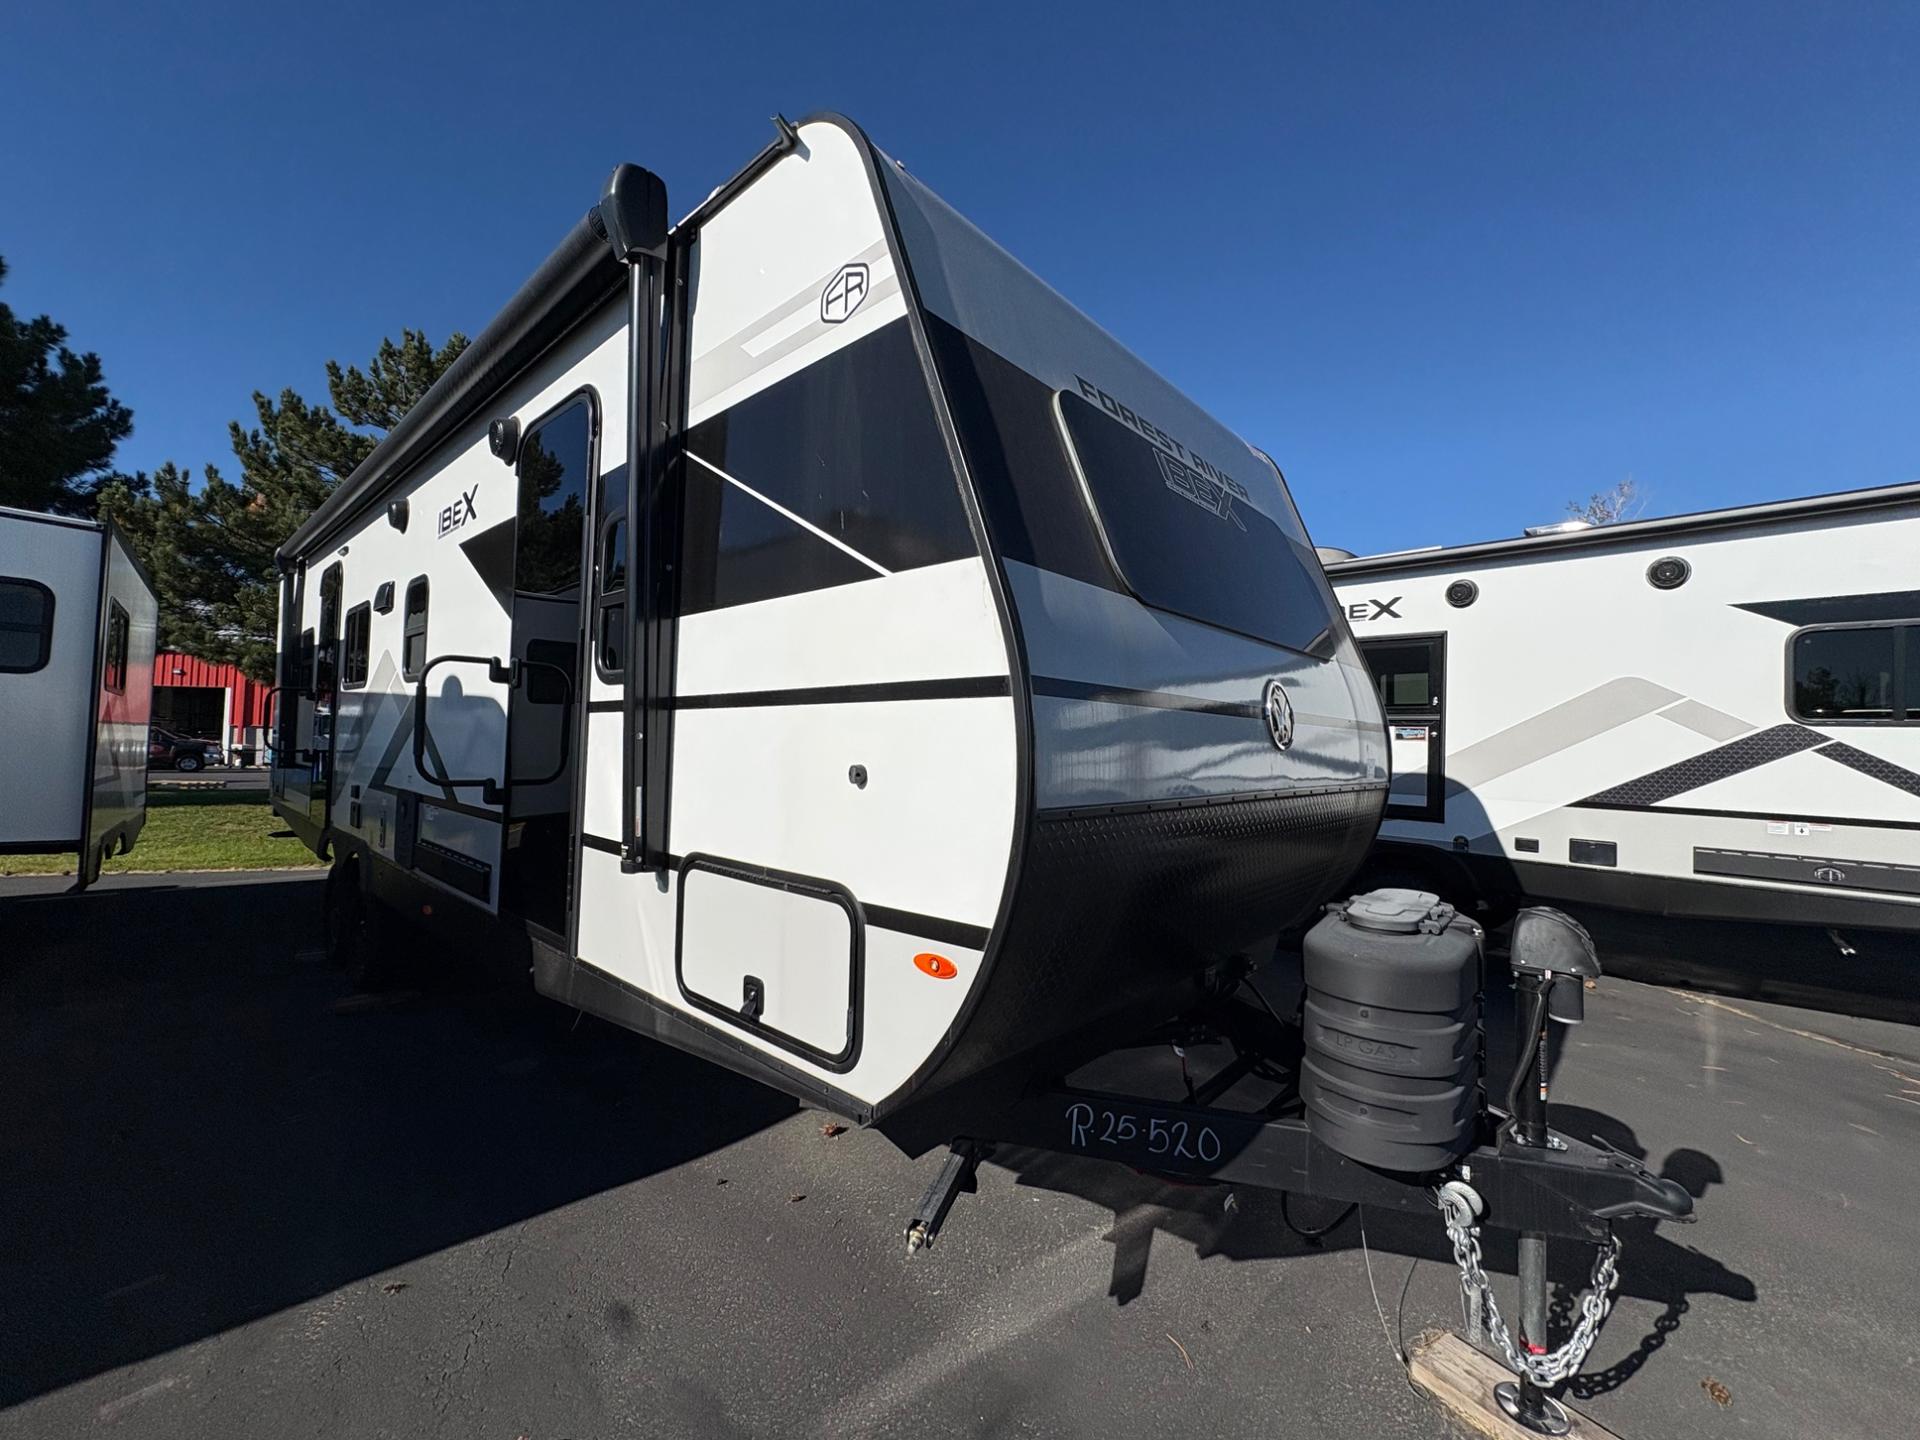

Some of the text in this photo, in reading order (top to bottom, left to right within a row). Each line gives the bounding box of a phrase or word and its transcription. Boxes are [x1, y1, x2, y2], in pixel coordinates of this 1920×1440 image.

[1073, 373, 1250, 500] FOREST RIVER
[438, 483, 479, 535] IBEX
[1152, 447, 1248, 532] IBEX
[1358, 1040, 1398, 1059] GAS
